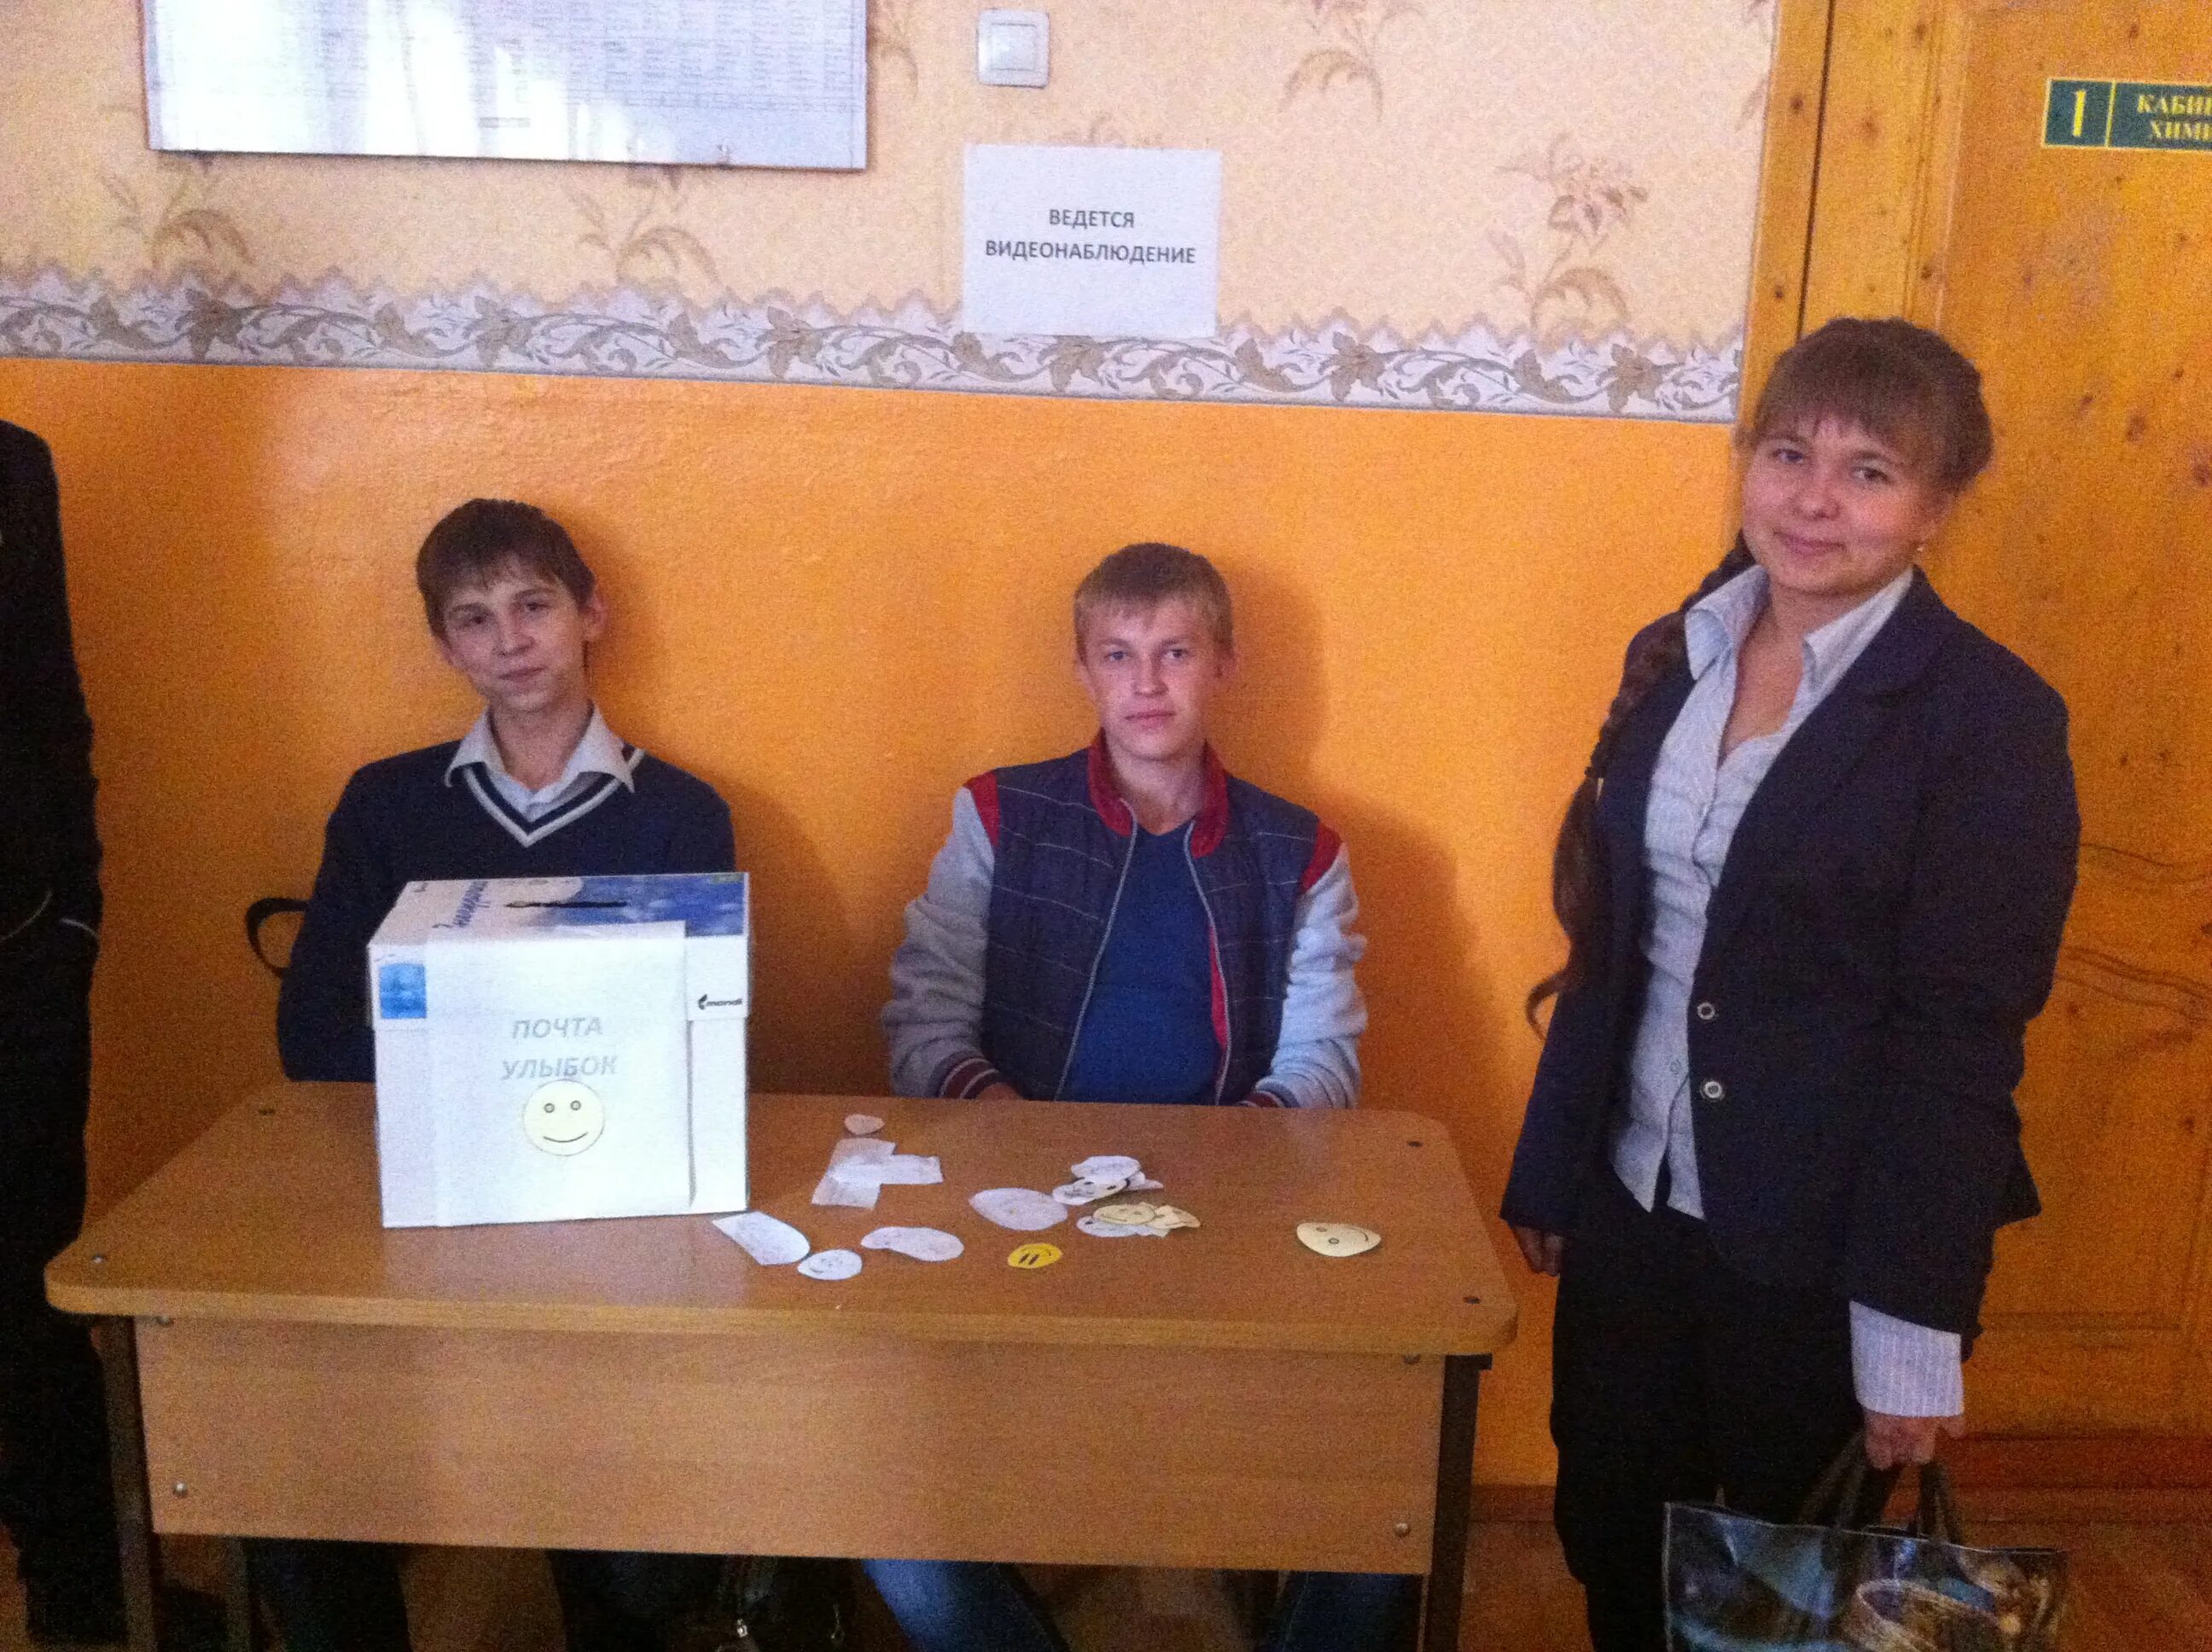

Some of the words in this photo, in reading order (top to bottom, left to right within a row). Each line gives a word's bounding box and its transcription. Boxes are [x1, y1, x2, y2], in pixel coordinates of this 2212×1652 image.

[2071, 89, 2087, 138] 1
[1049, 208, 1135, 230] ВЕДЕТСЯ
[986, 240, 1196, 265] ВИДЕОНАБЛЮДЕНИЕ
[512, 1016, 603, 1039] ПОЧТА
[501, 1055, 617, 1080] УЛЫБОК
